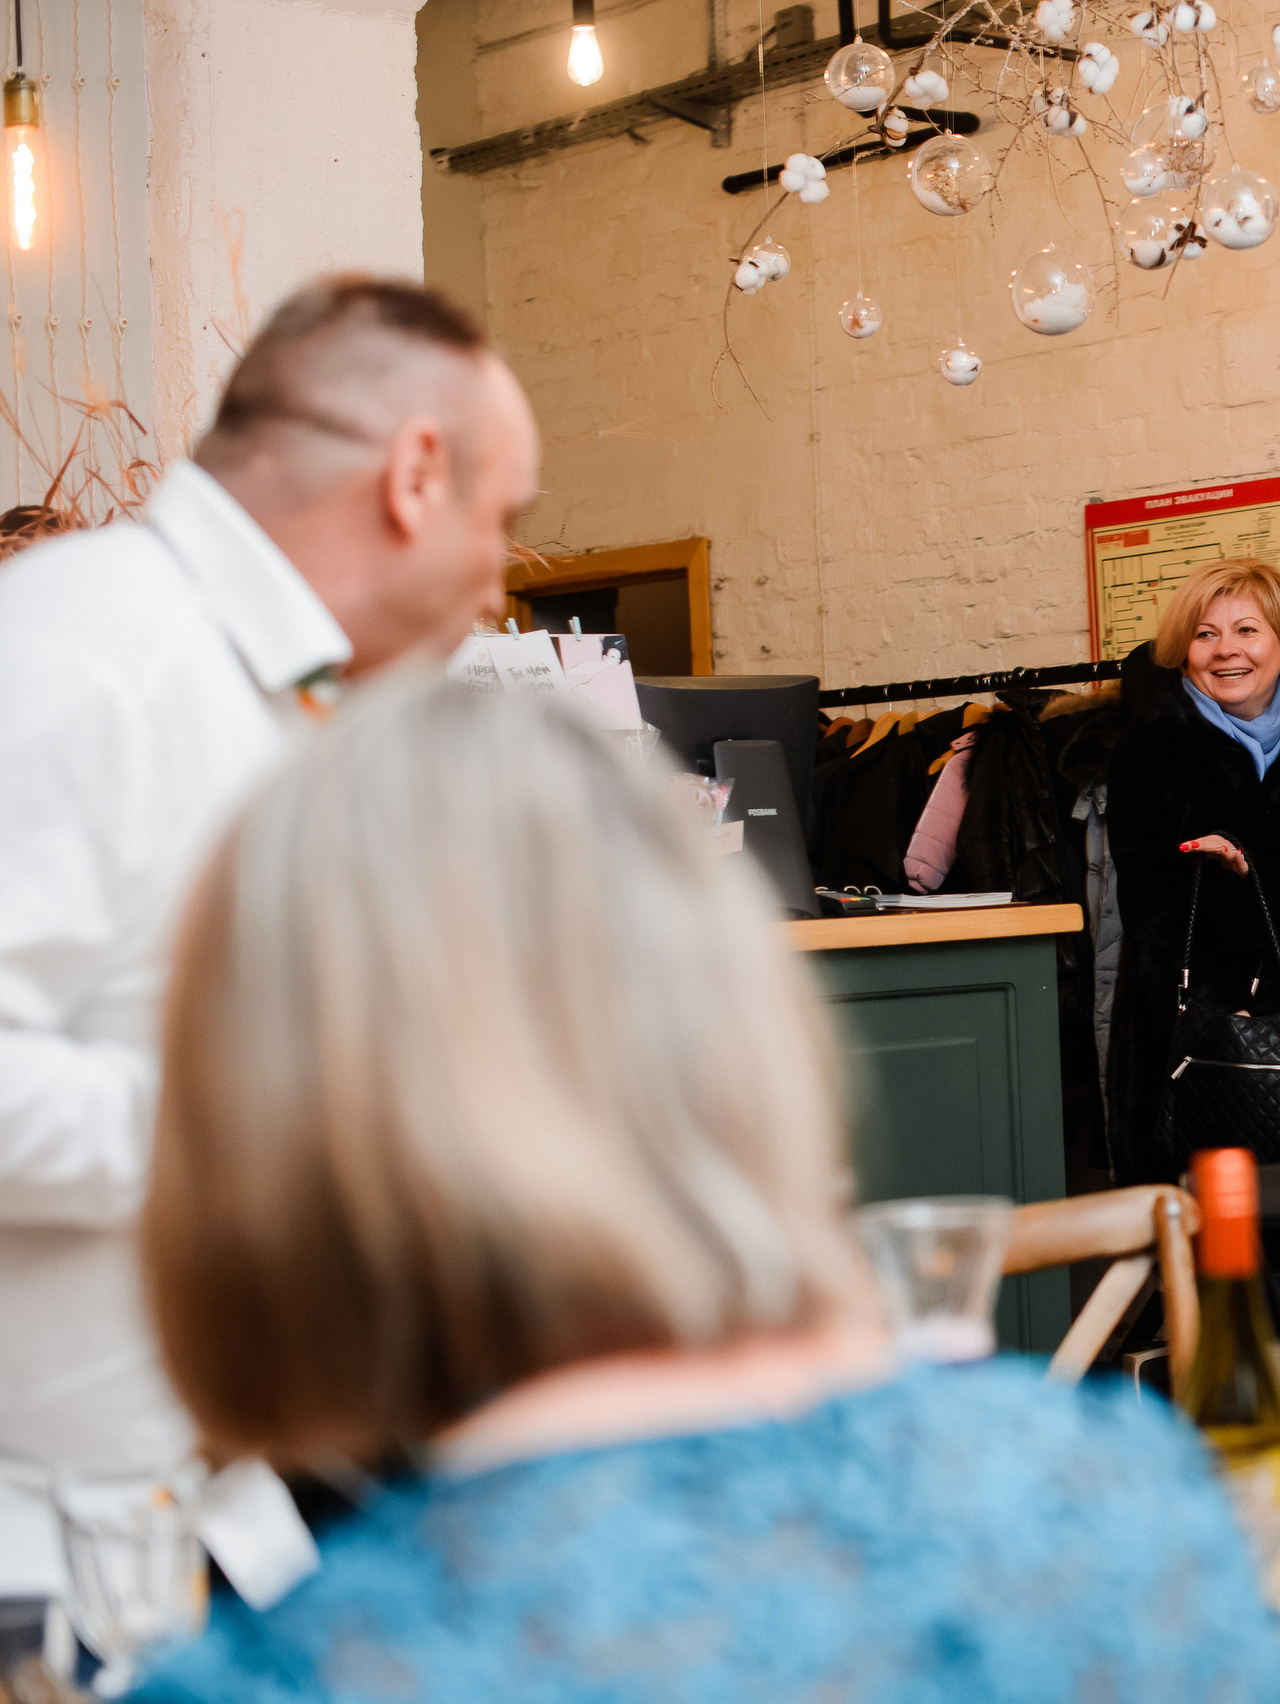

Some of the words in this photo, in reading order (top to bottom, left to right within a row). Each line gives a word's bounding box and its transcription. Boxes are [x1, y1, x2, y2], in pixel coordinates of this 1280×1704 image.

[1145, 497, 1173, 509] ПЛАН
[1174, 488, 1234, 505] ЭВАКУАЦИИ
[748, 808, 778, 816] POSBANK
